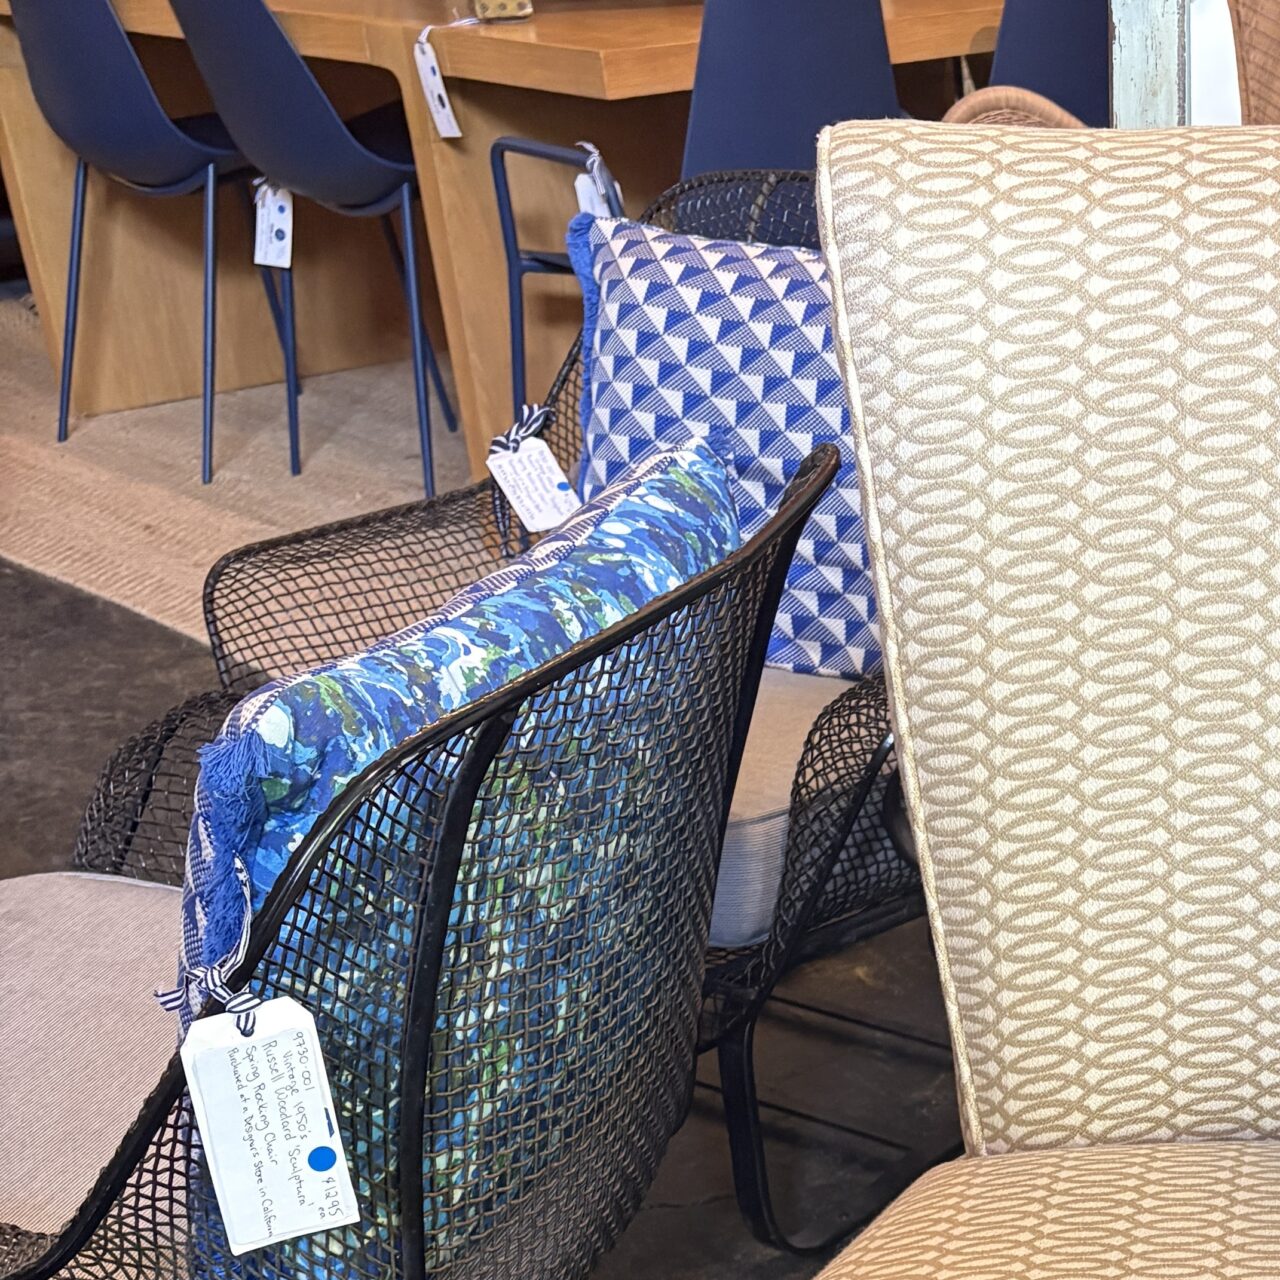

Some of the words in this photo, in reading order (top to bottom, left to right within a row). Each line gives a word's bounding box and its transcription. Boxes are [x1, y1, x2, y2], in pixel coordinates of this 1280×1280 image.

[228, 1047, 247, 1091] Purchased
[240, 1093, 250, 1103] at
[254, 1160, 263, 1184] Store
[259, 1187, 266, 1197] in
[243, 1045, 260, 1082] Spring
[254, 1082, 269, 1131] Rocking
[264, 1132, 277, 1165] Chair
[262, 1039, 284, 1082] Russell
[275, 1086, 296, 1140] Woodard
[283, 1049, 299, 1096] Vintage
[294, 1100, 311, 1139] 1950's
[322, 1176, 343, 1216] $1295
